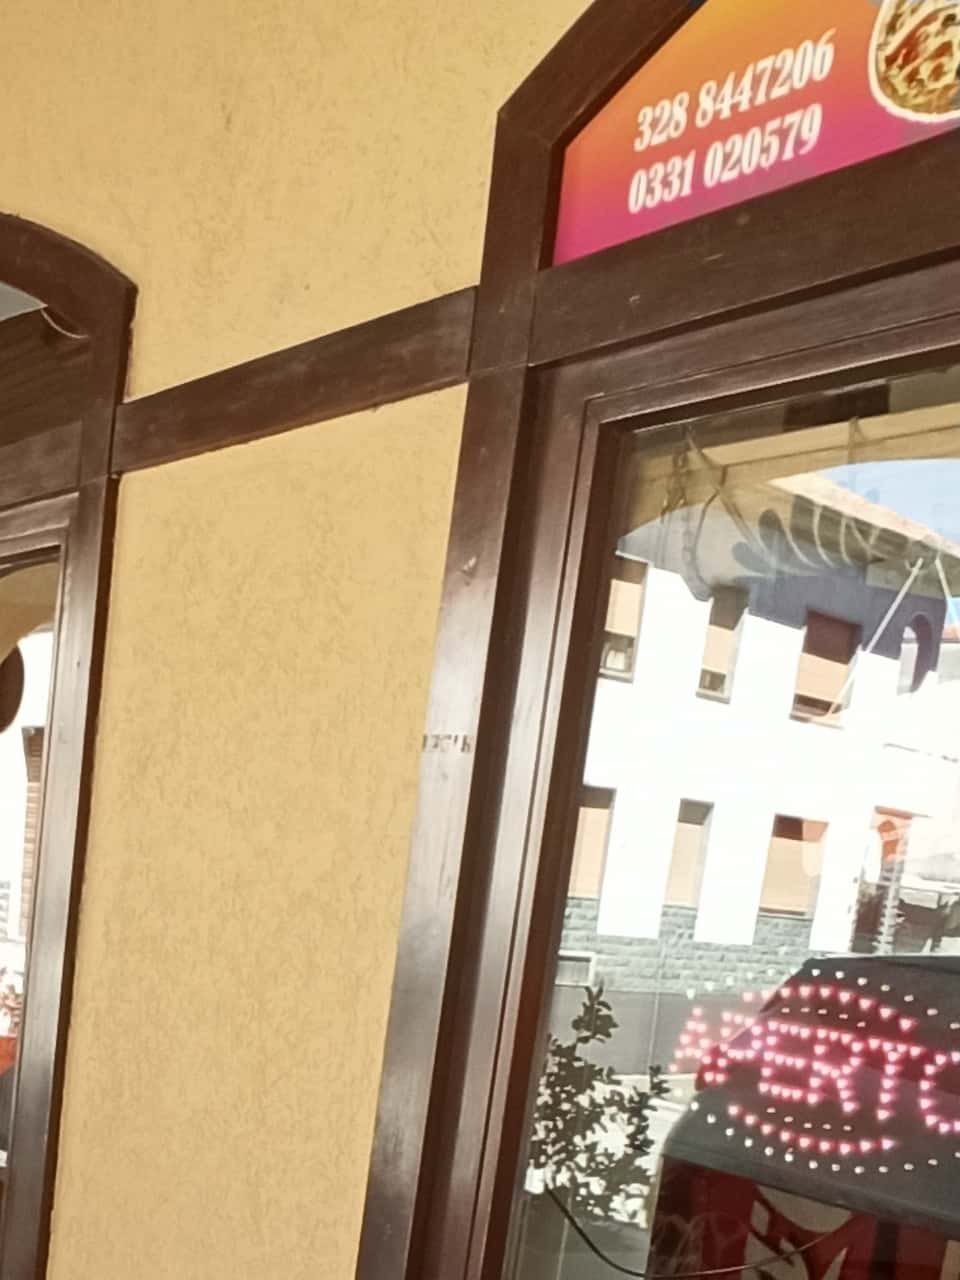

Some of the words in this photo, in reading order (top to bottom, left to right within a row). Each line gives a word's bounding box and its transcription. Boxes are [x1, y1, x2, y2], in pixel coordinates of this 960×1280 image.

[633, 92, 689, 152] 328
[695, 27, 837, 129] 8447206
[627, 150, 696, 215] 0331
[703, 103, 823, 189] 020579
